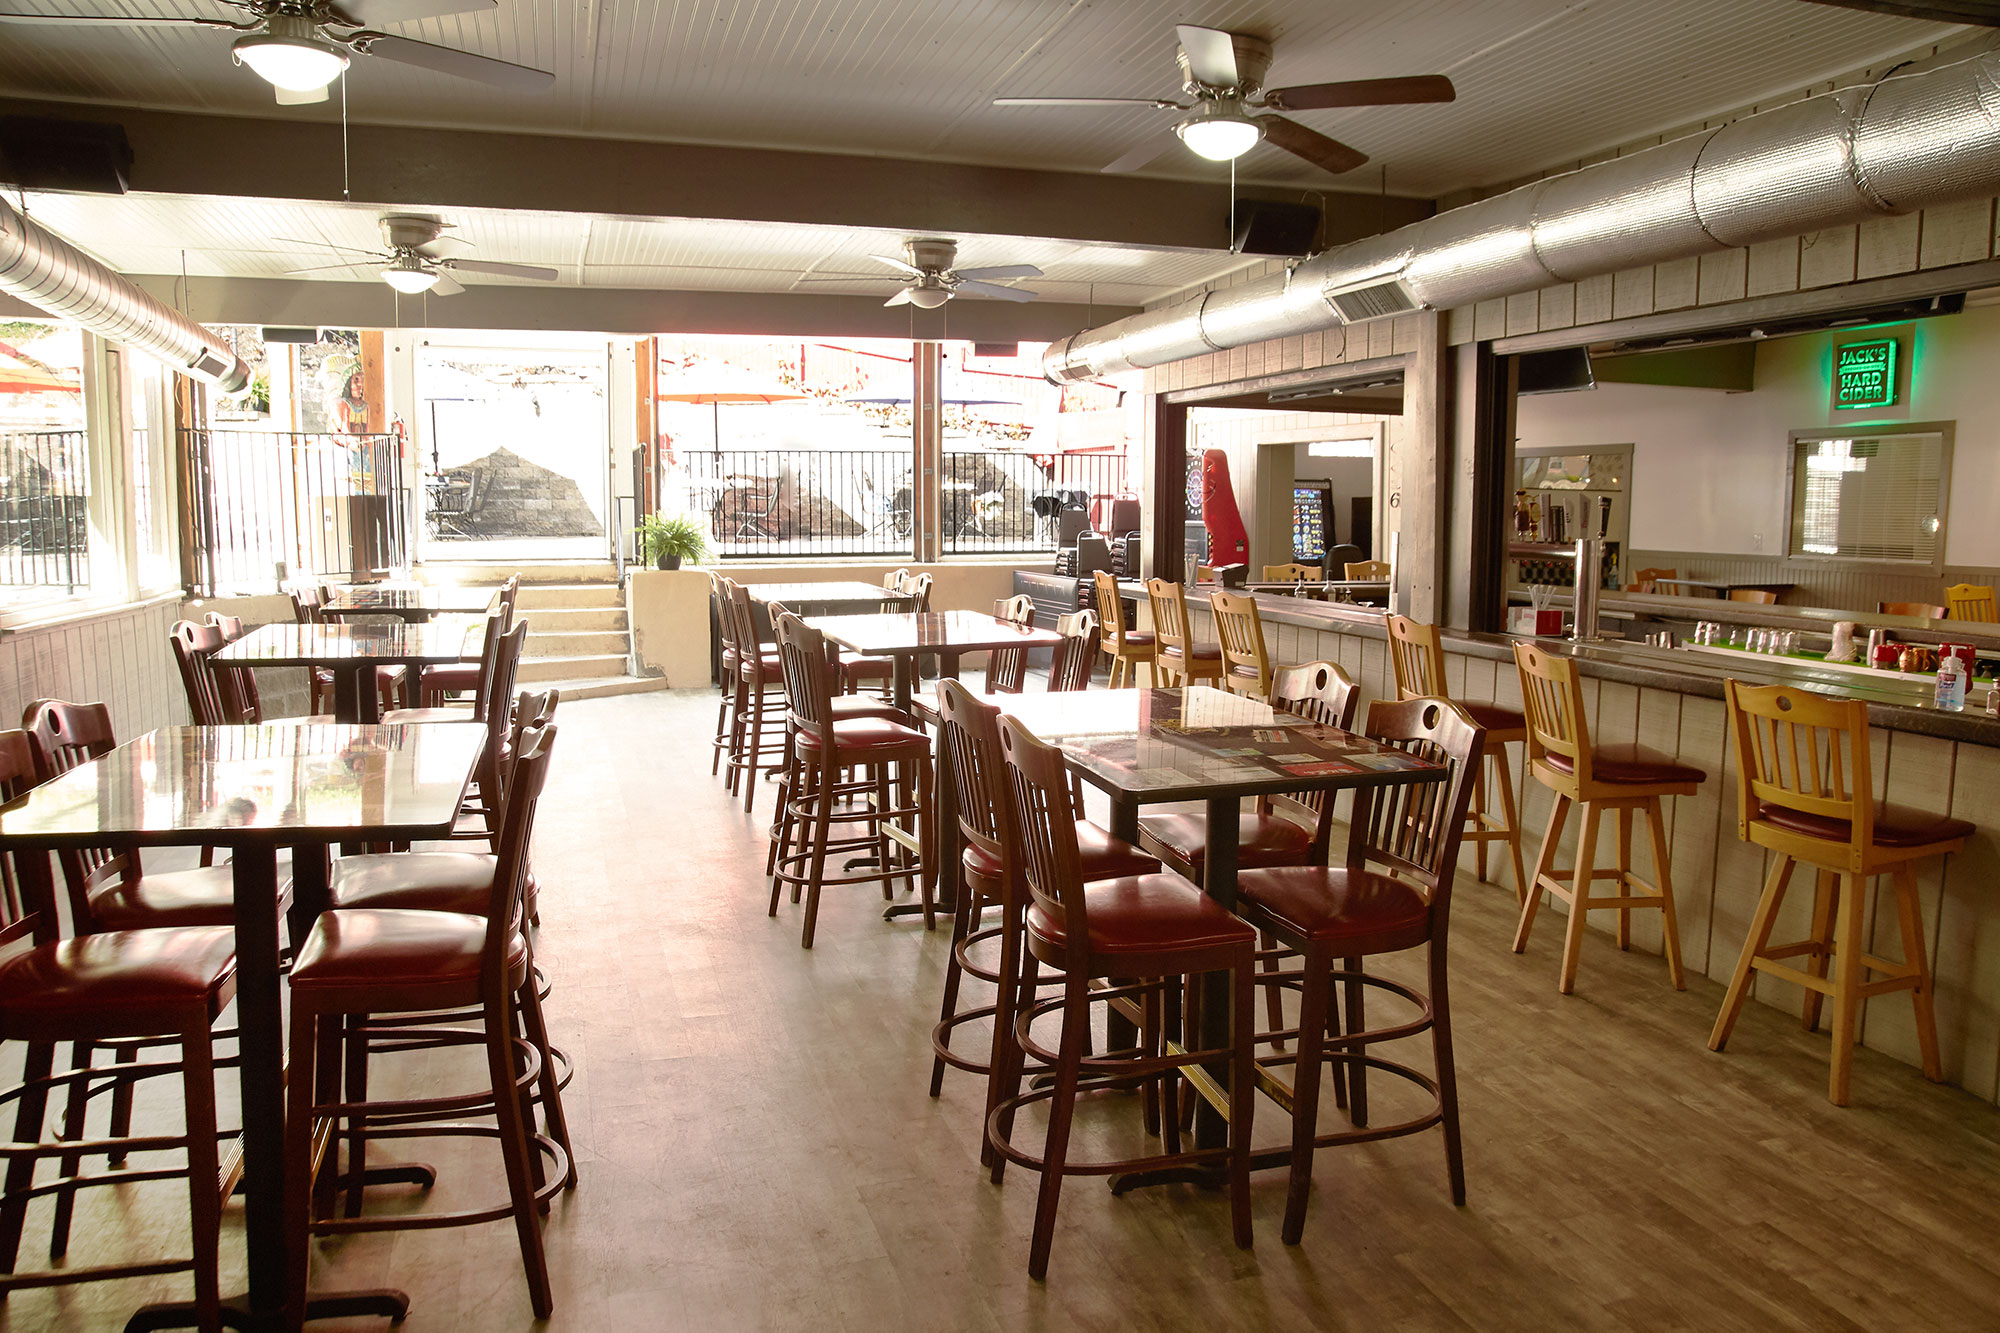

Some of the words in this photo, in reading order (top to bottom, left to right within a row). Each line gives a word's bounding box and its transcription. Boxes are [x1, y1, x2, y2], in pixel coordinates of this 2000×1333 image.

[1840, 347, 1886, 365] JACK'S
[1841, 371, 1882, 388] HARD
[1839, 385, 1882, 401] CIDER
